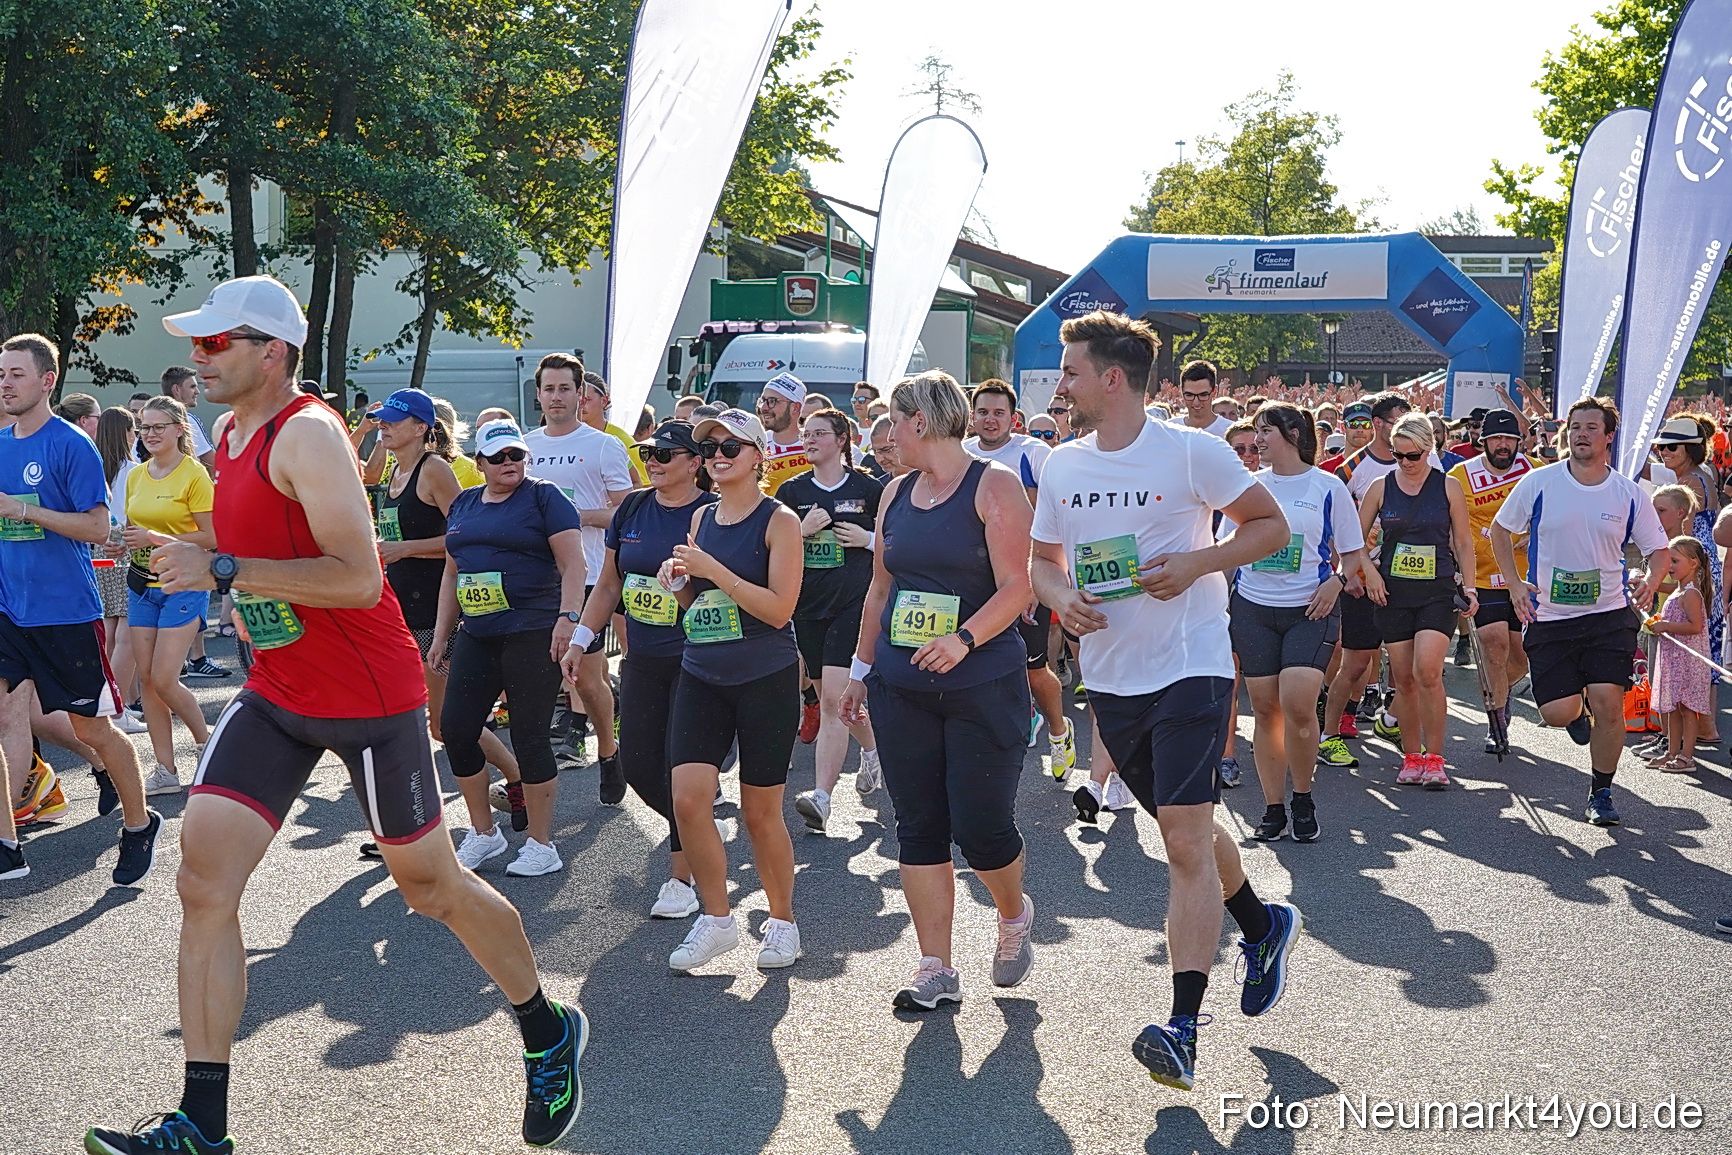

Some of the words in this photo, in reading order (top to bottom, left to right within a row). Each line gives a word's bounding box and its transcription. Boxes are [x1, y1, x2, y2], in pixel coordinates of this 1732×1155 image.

[1600, 134, 1645, 238] Fischer
[1240, 271, 1329, 288] firmenlauf
[1069, 300, 1116, 310] Fischer
[1632, 239, 1722, 450] www.fischer-automobile.de
[724, 360, 765, 370] abavent
[527, 455, 576, 466] APTIV
[1071, 491, 1149, 508] APTIV
[1474, 491, 1506, 507] MAX
[807, 543, 831, 556] 420
[1401, 556, 1425, 568] 489
[1084, 560, 1120, 584] 219
[466, 588, 491, 603] 483
[494, 588, 505, 606] 2022
[1562, 582, 1589, 595] 320
[633, 591, 663, 610] 492
[667, 599, 676, 620] 2022
[239, 602, 280, 627] 1313
[277, 602, 299, 633] 2022
[694, 607, 722, 626] 493
[728, 608, 739, 633] 2022
[903, 610, 937, 631] 491
[262, 627, 283, 636] Bernd
[892, 612, 900, 638] WALK
[945, 618, 954, 636] 022
[187, 1070, 224, 1081] ACER
